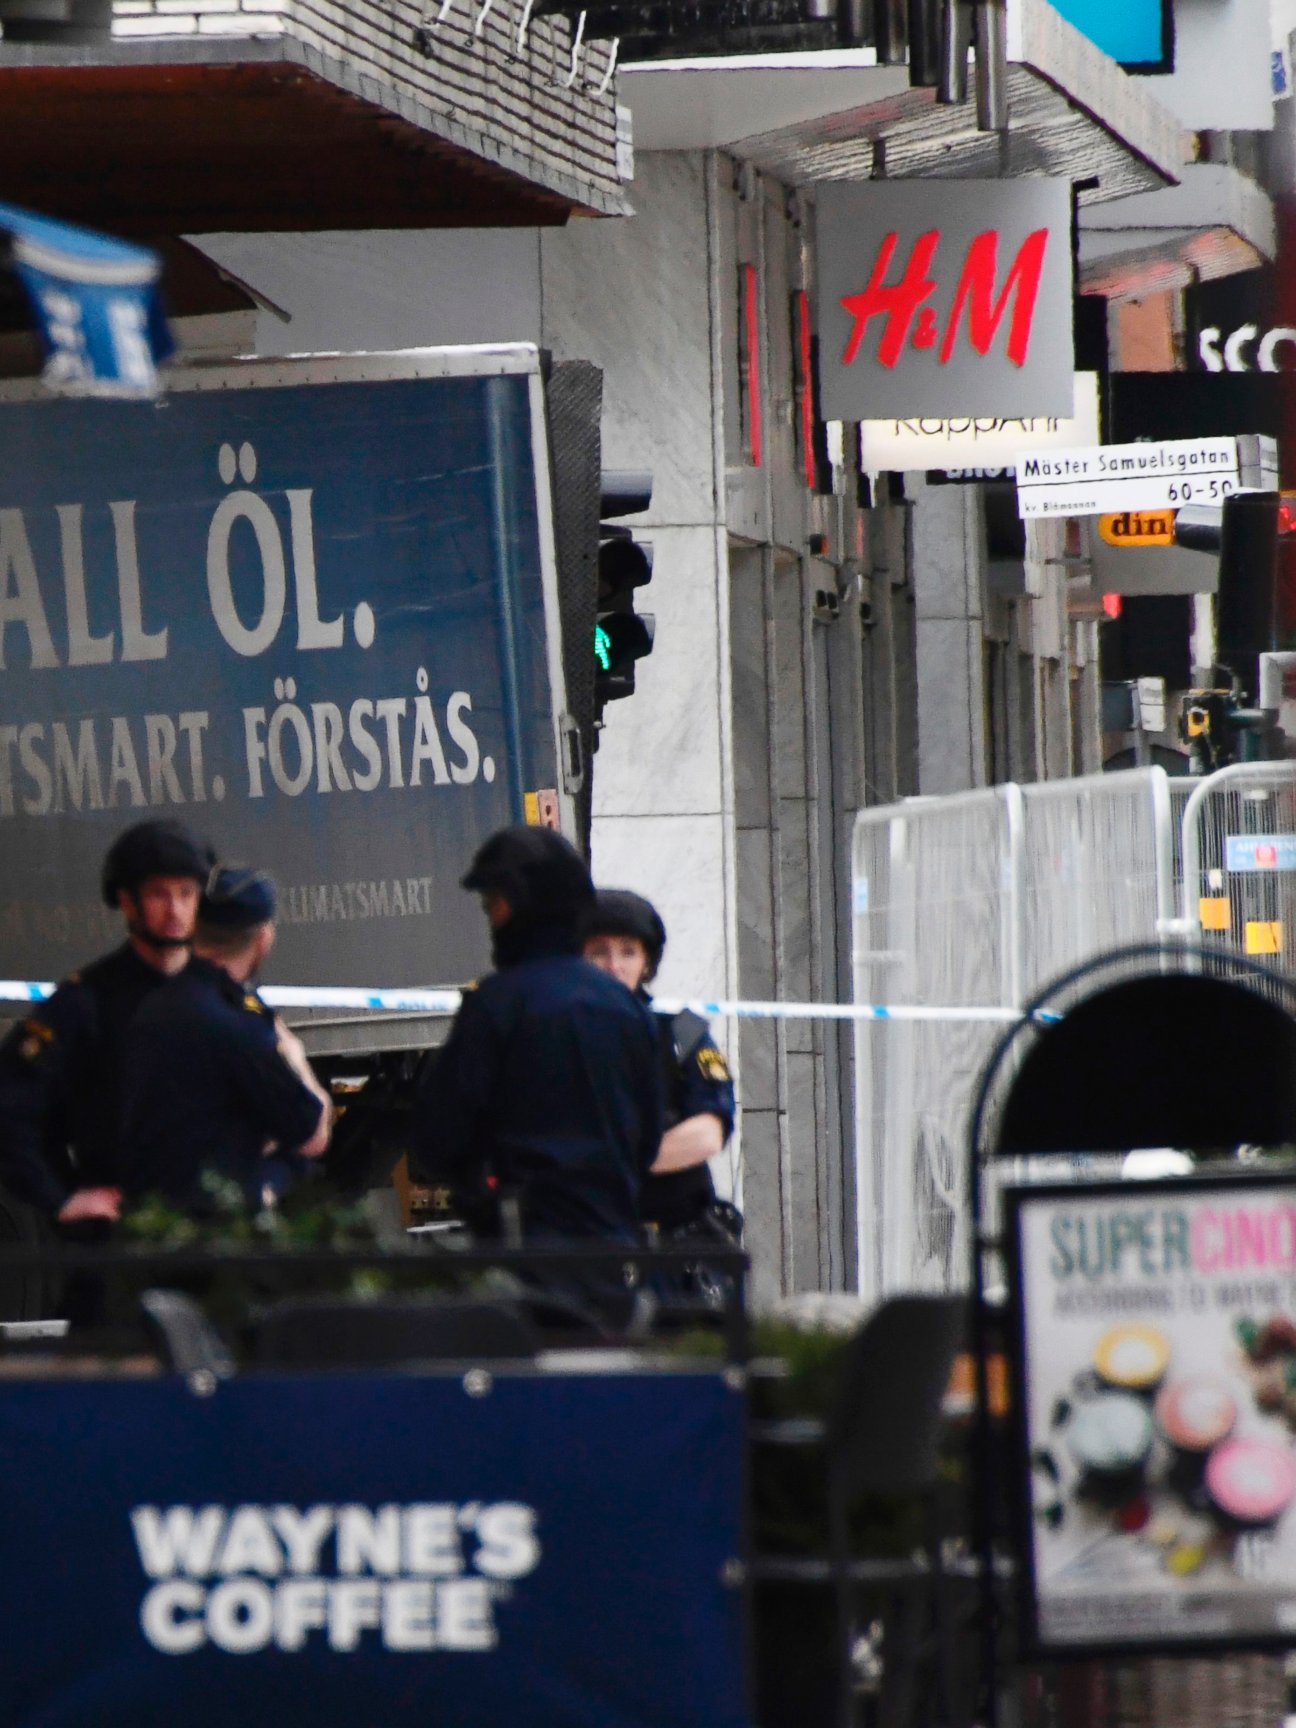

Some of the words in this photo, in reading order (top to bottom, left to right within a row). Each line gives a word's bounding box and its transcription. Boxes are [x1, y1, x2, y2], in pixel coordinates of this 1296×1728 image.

[840, 227, 1050, 369] H&M
[1024, 458, 1090, 477] Mäster
[1099, 448, 1230, 472] Samuelsgatan
[1168, 479, 1233, 502] 60-50
[206, 441, 376, 657] ÖL.
[1110, 512, 1168, 537] din
[243, 665, 496, 798] FÖRSTÅS.
[129, 1501, 542, 1580] WAYNE'S
[140, 1576, 500, 1655] COFFEE
